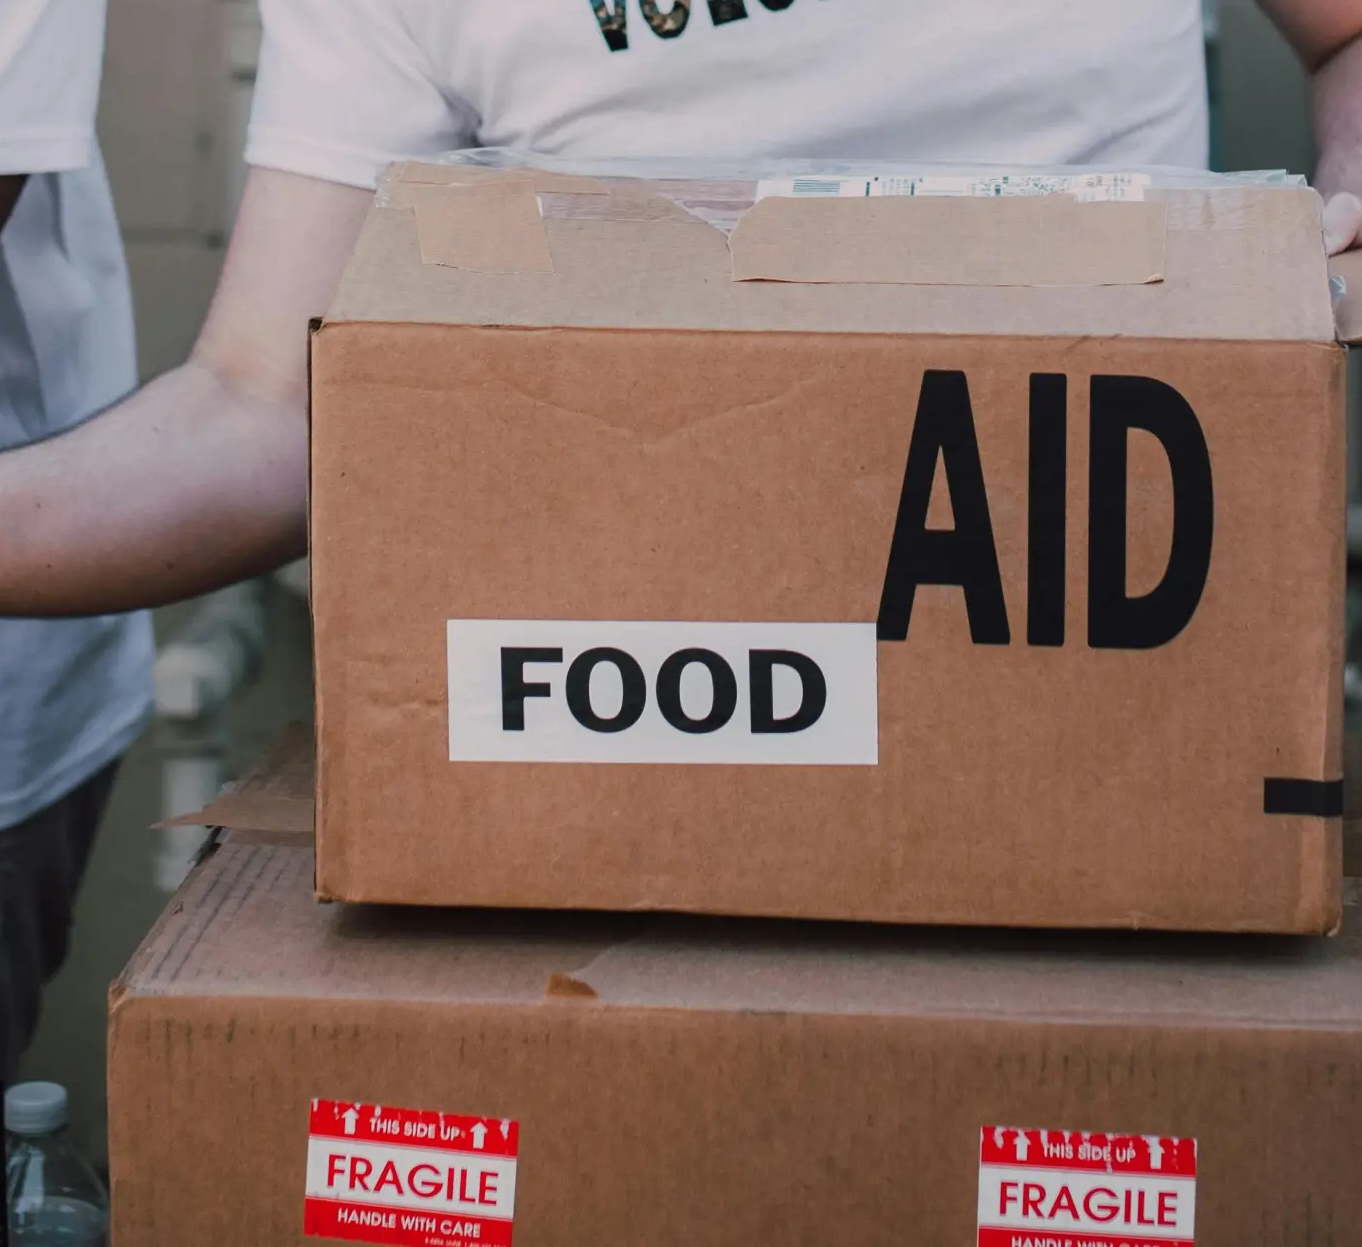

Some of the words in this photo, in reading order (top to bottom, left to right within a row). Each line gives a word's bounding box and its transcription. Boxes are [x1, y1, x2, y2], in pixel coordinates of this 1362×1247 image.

[876, 368, 1215, 651] AID
[500, 645, 828, 735] FOOD
[370, 1117, 399, 1135] THIS
[404, 1121, 436, 1140] SIDE
[439, 1123, 459, 1142] UP
[1043, 1143, 1073, 1160] THIS
[1078, 1144, 1111, 1162] SIDE
[1116, 1148, 1137, 1163] UP
[327, 1153, 498, 1207] FRAGILE
[338, 1208, 396, 1229] HANDLE
[401, 1215, 436, 1233] WITH
[440, 1220, 481, 1239] CARE
[999, 1181, 1177, 1227] FRAGILE
